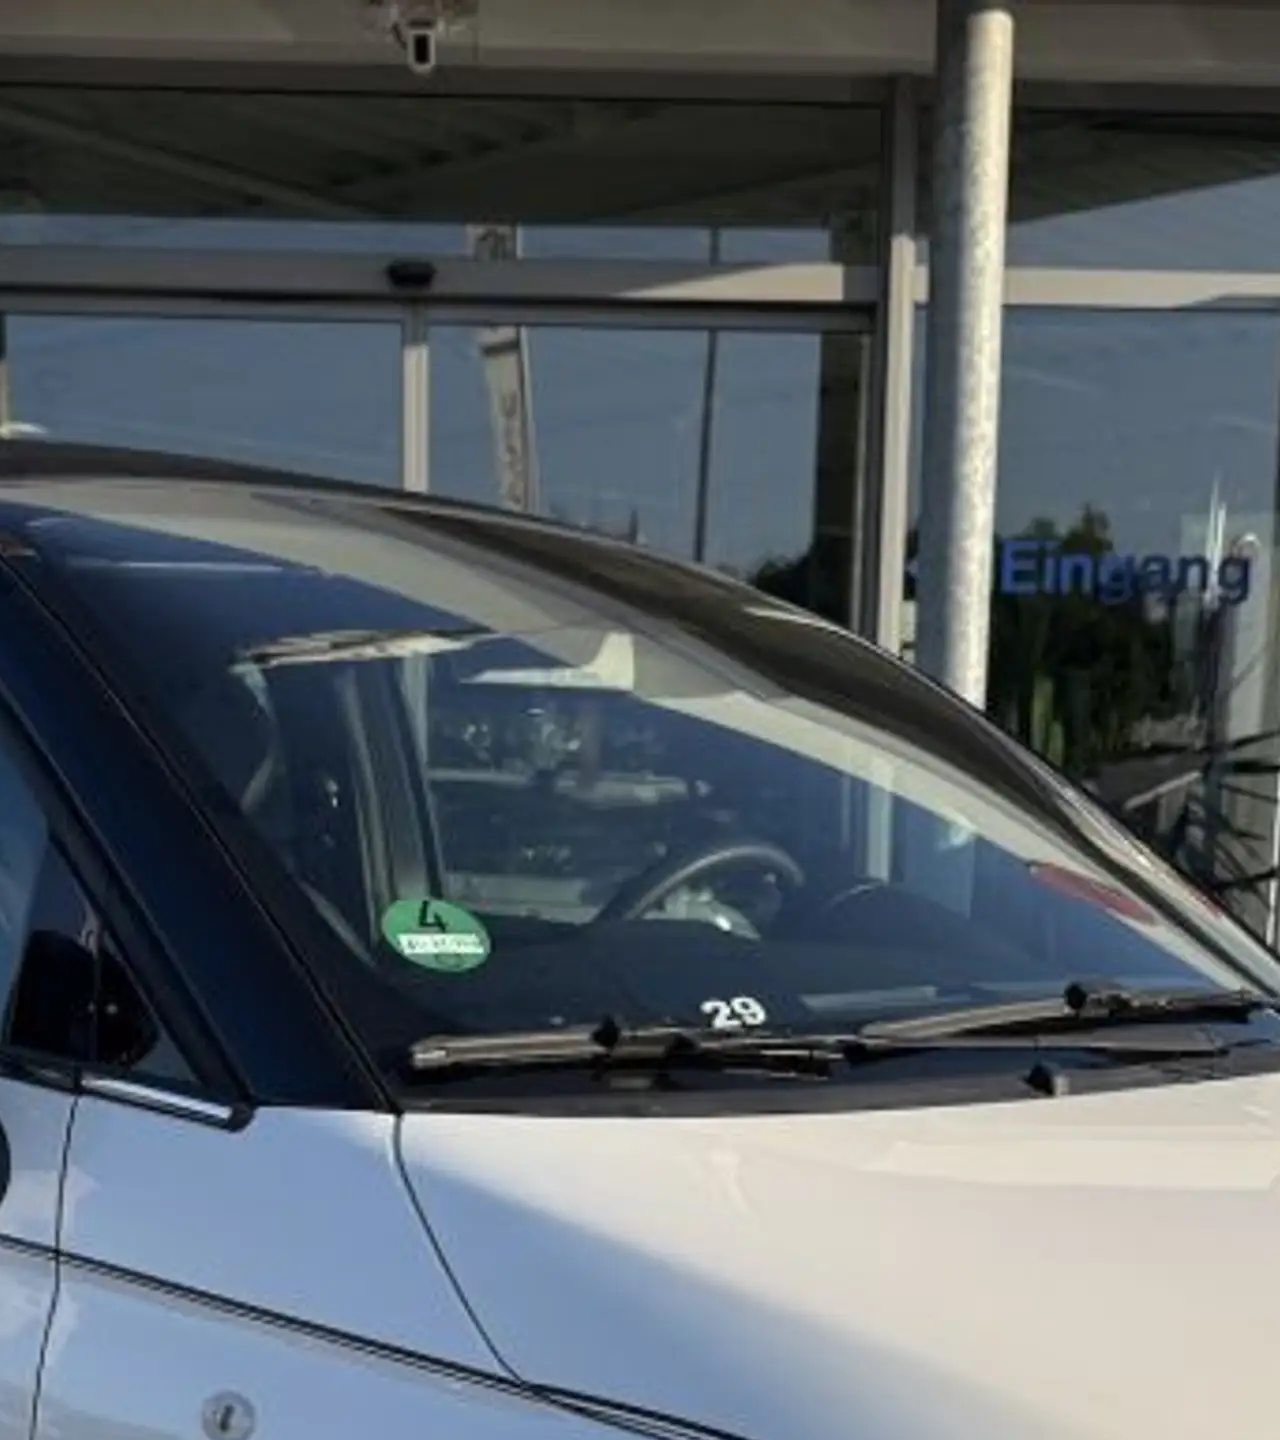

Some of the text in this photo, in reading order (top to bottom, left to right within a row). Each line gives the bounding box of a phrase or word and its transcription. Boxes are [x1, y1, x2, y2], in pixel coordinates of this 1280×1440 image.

[999, 539, 1251, 605] Eingang
[418, 899, 448, 933] 4
[700, 996, 767, 1029] 29
